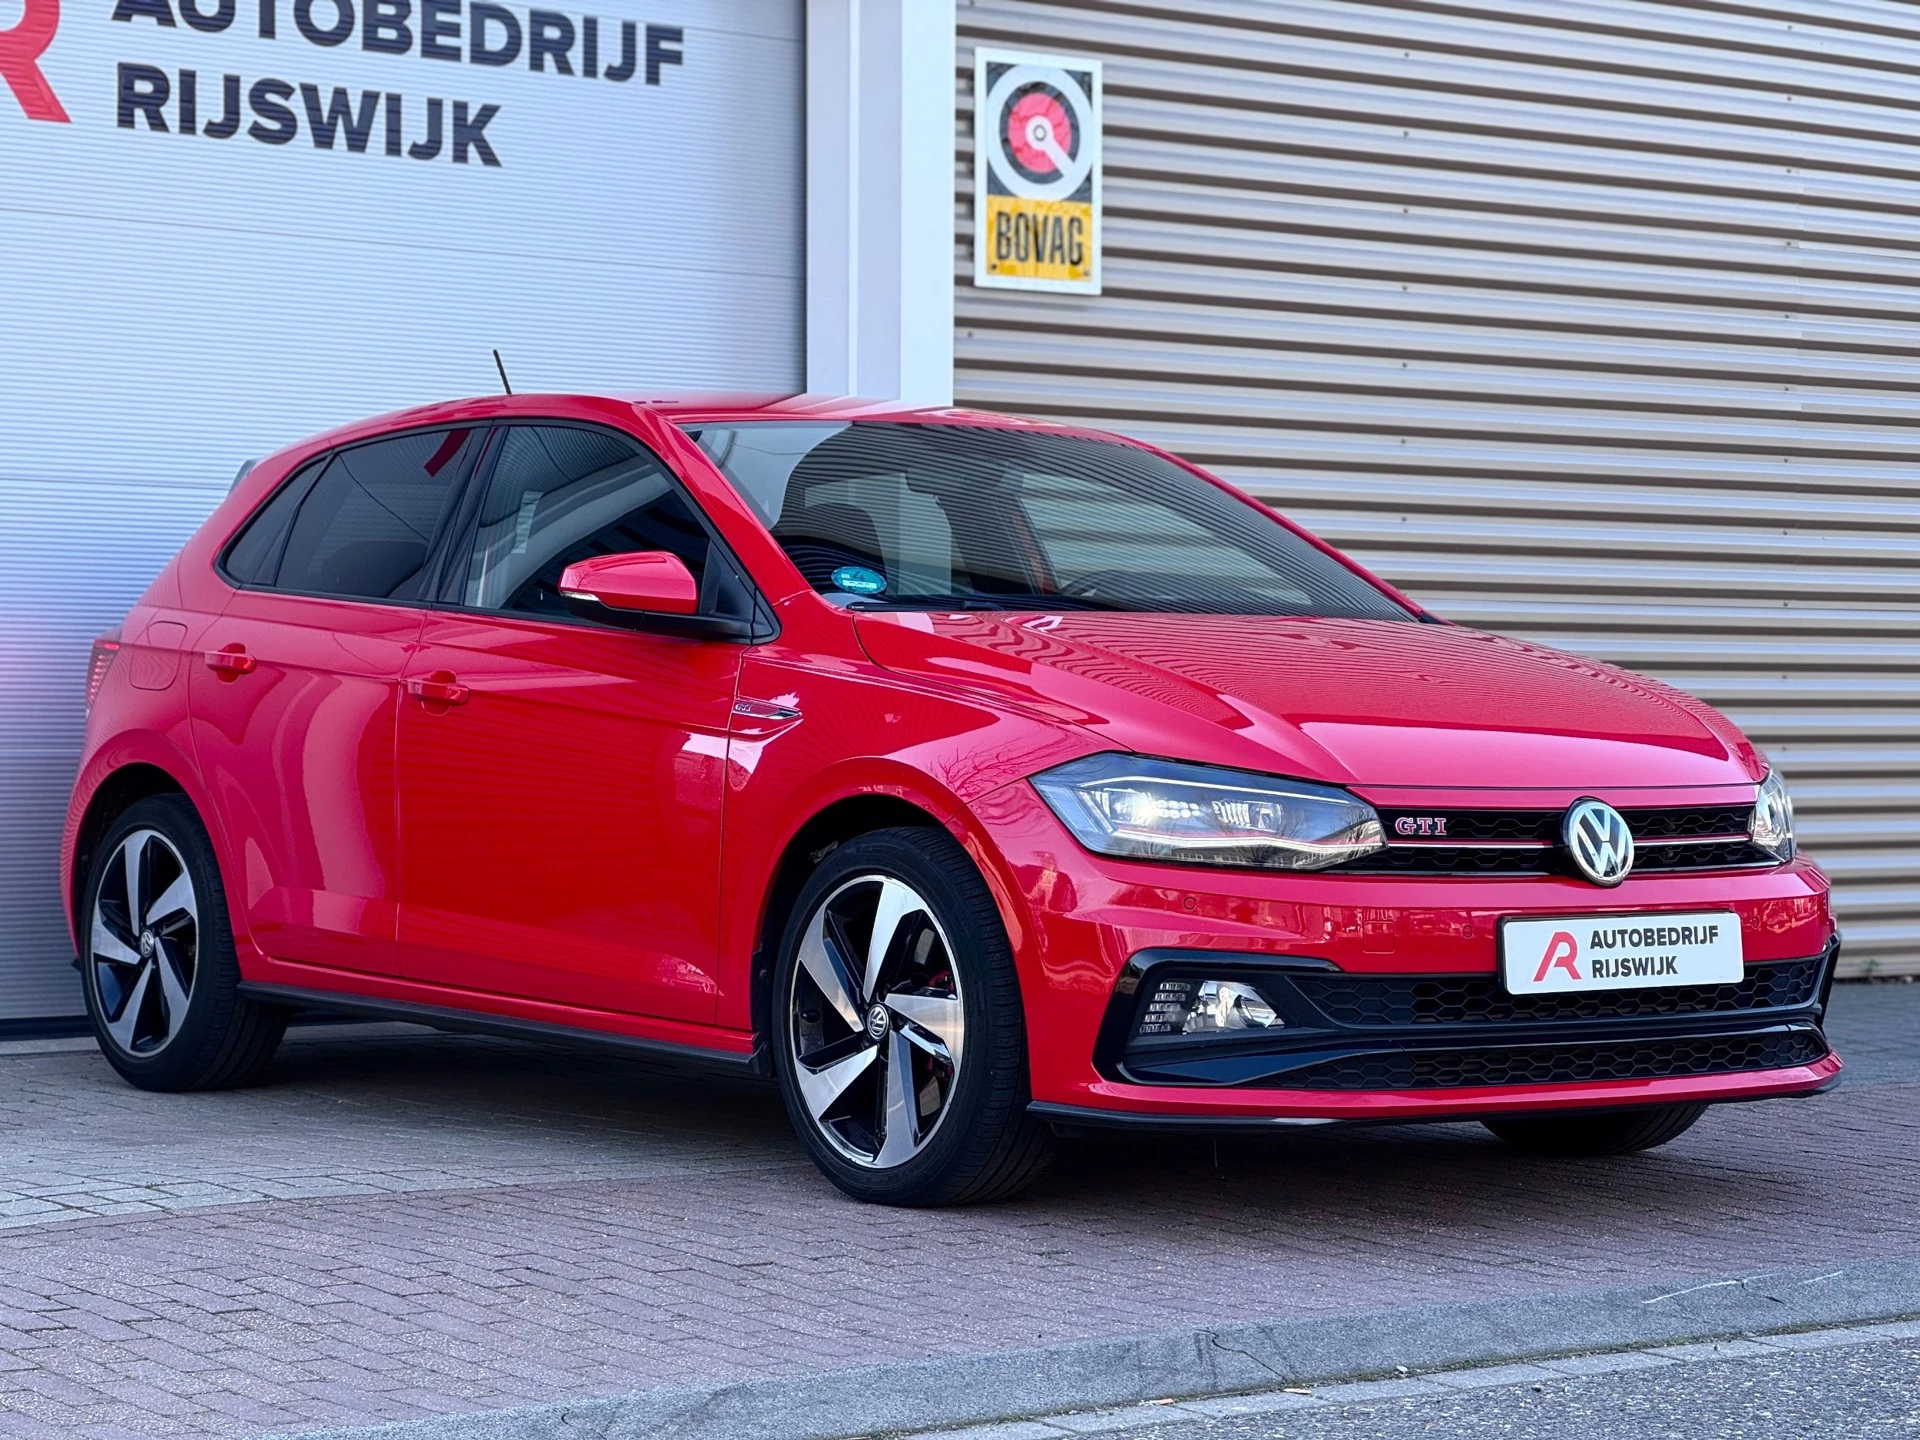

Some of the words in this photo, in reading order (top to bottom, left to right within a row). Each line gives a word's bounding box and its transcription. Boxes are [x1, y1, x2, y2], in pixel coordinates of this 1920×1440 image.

[117, 62, 502, 167] RIJSWIJK
[996, 211, 1083, 266] BOVAG
[1395, 817, 1447, 835] GTI
[1590, 925, 1719, 949] AUTOBEDRIJF
[1592, 956, 1678, 979] RIJSWIJK
